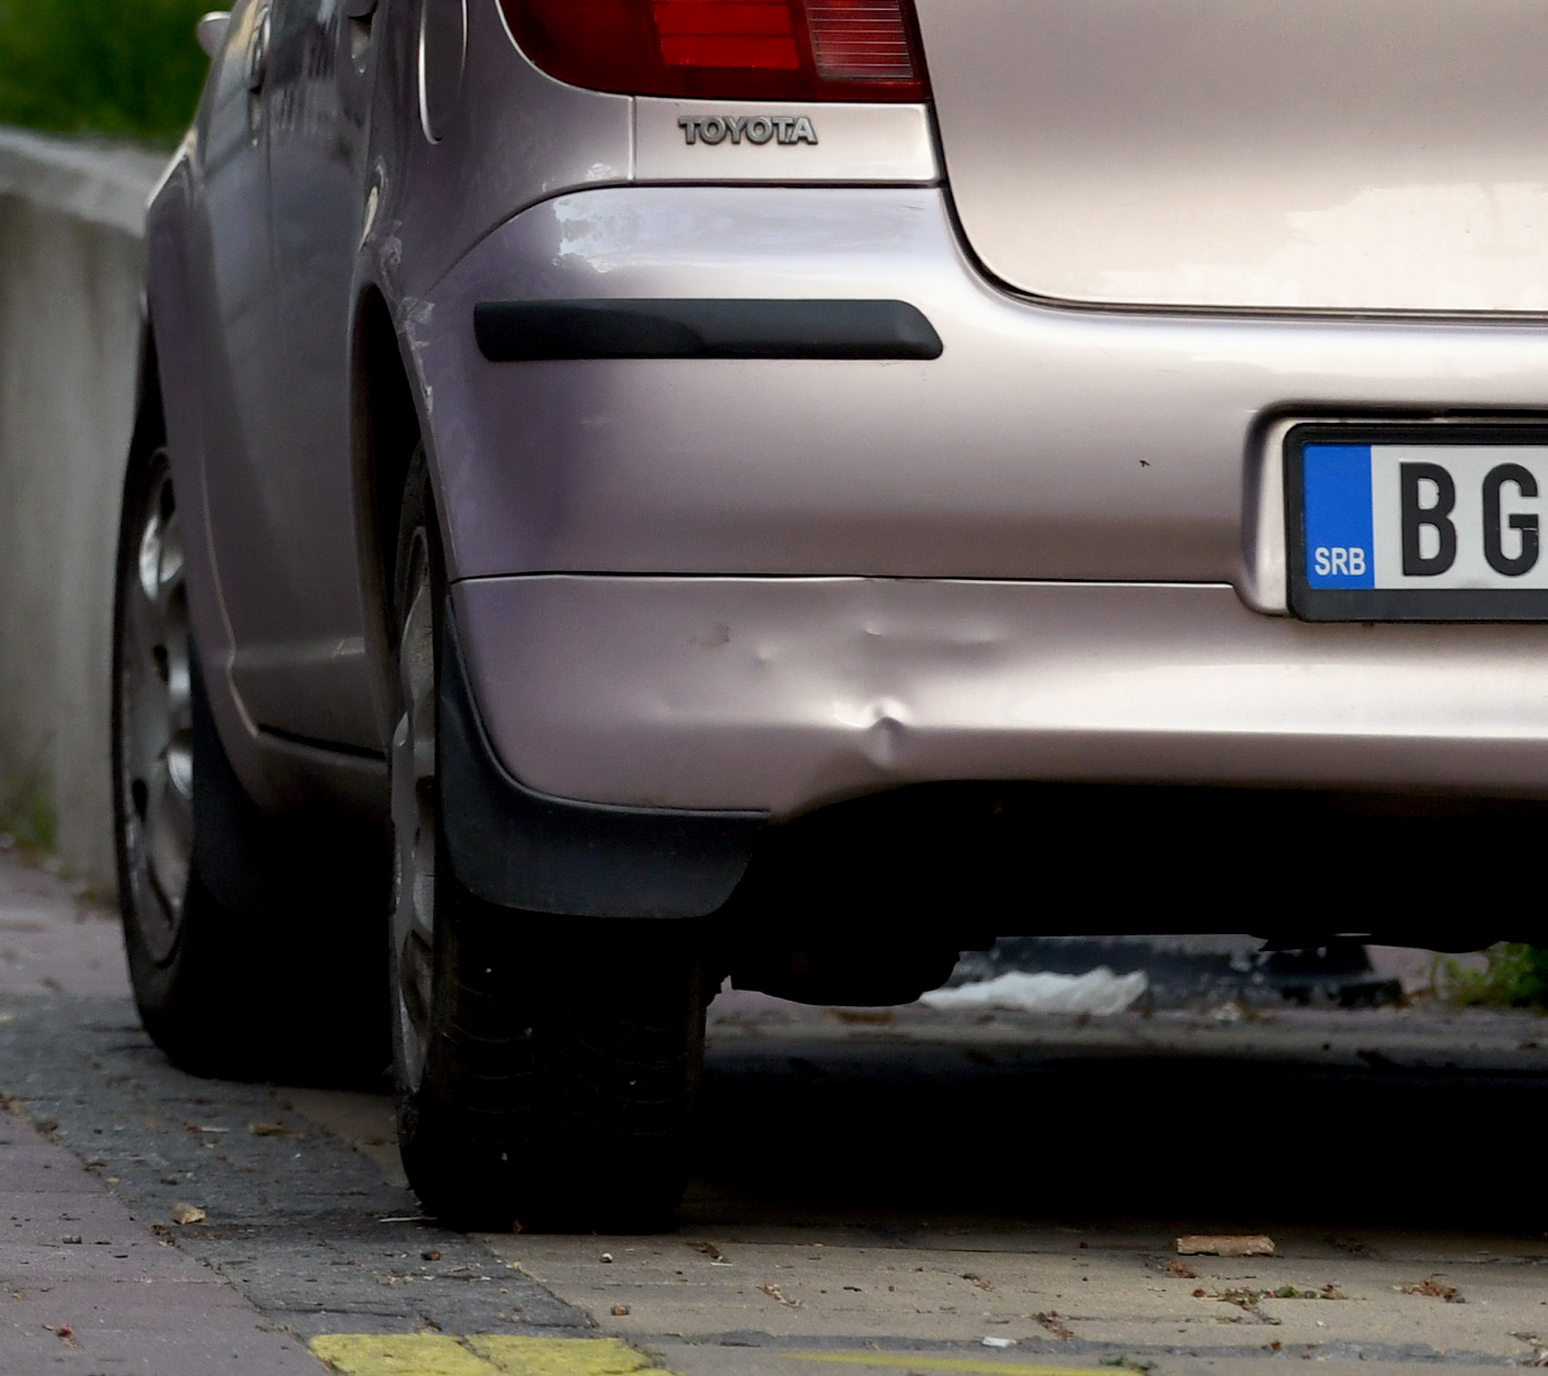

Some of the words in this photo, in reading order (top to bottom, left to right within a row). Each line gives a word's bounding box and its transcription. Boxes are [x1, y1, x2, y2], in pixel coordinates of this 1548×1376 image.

[679, 116, 818, 145] TOYOTA
[1400, 461, 1540, 577] BG
[1315, 547, 1366, 576] SRB
